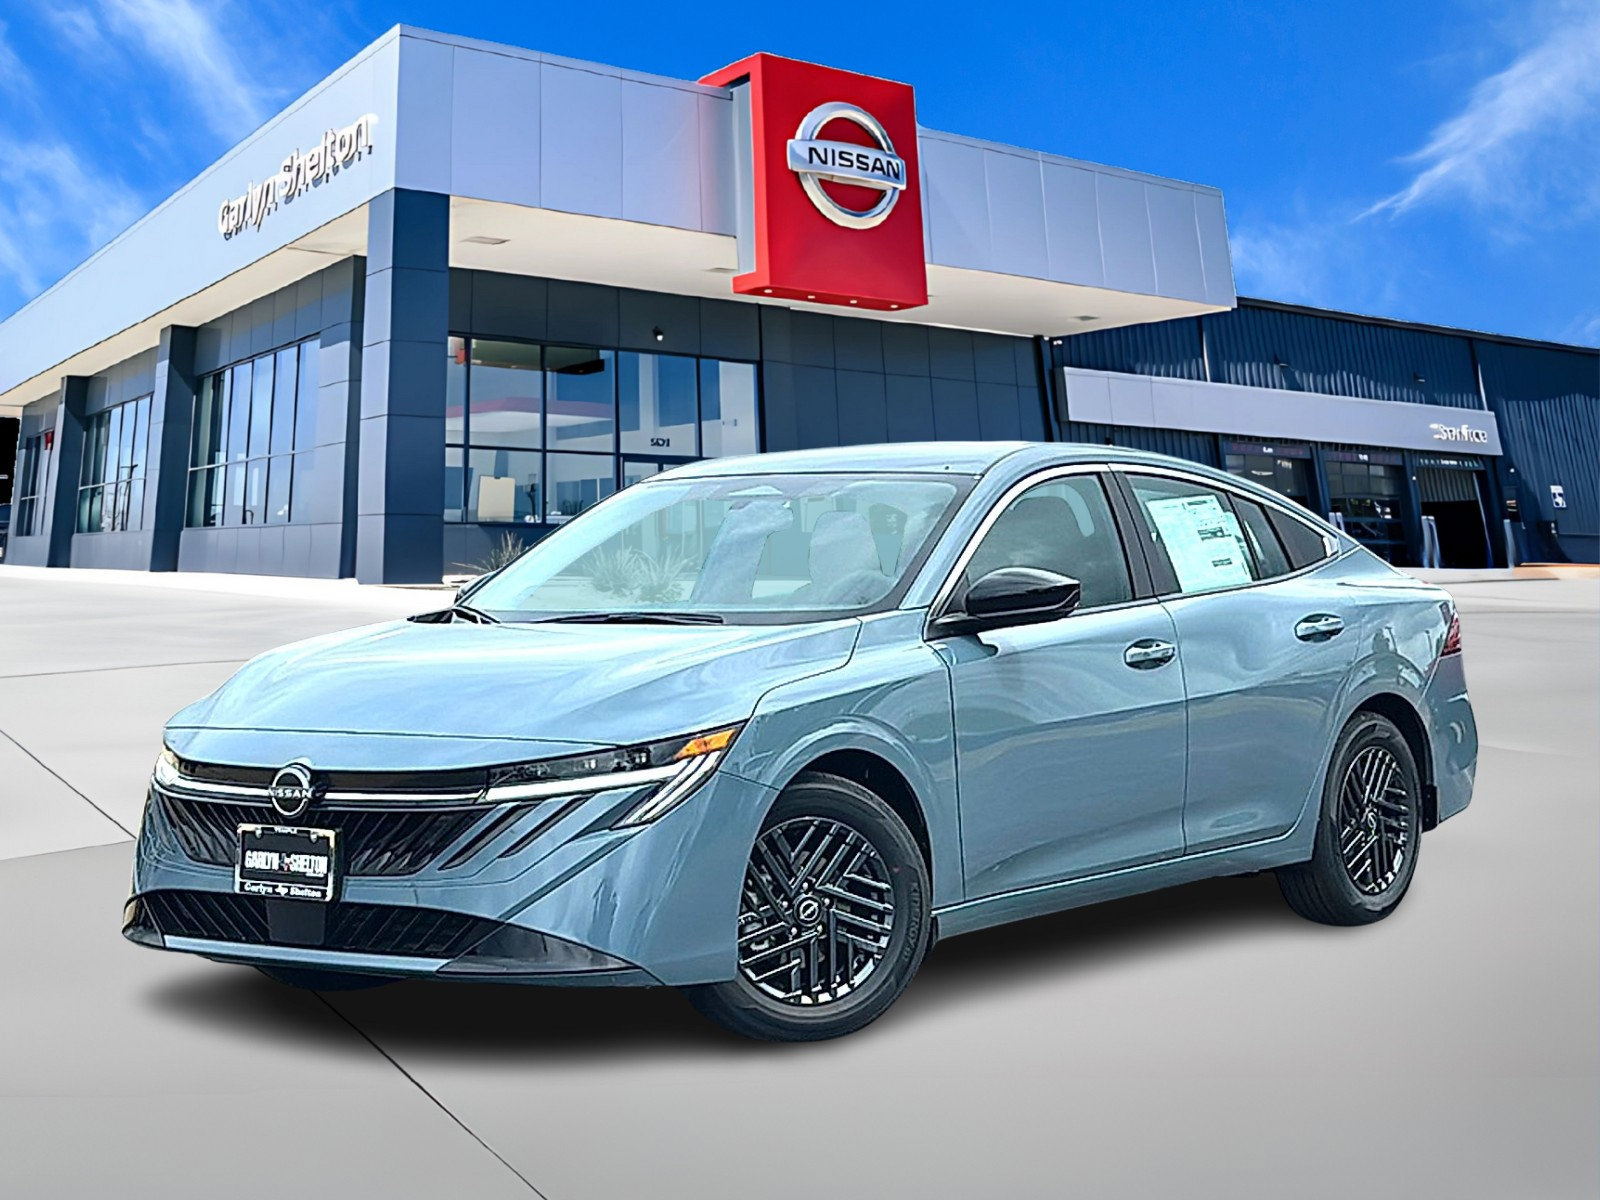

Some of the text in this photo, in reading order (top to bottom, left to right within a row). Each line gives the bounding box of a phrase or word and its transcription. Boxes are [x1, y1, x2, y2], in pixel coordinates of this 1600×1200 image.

[279, 114, 377, 203] Shelton
[808, 147, 900, 180] NISSAN
[268, 787, 313, 799] NISSAN
[245, 850, 328, 874] GARLYN SHELTON
